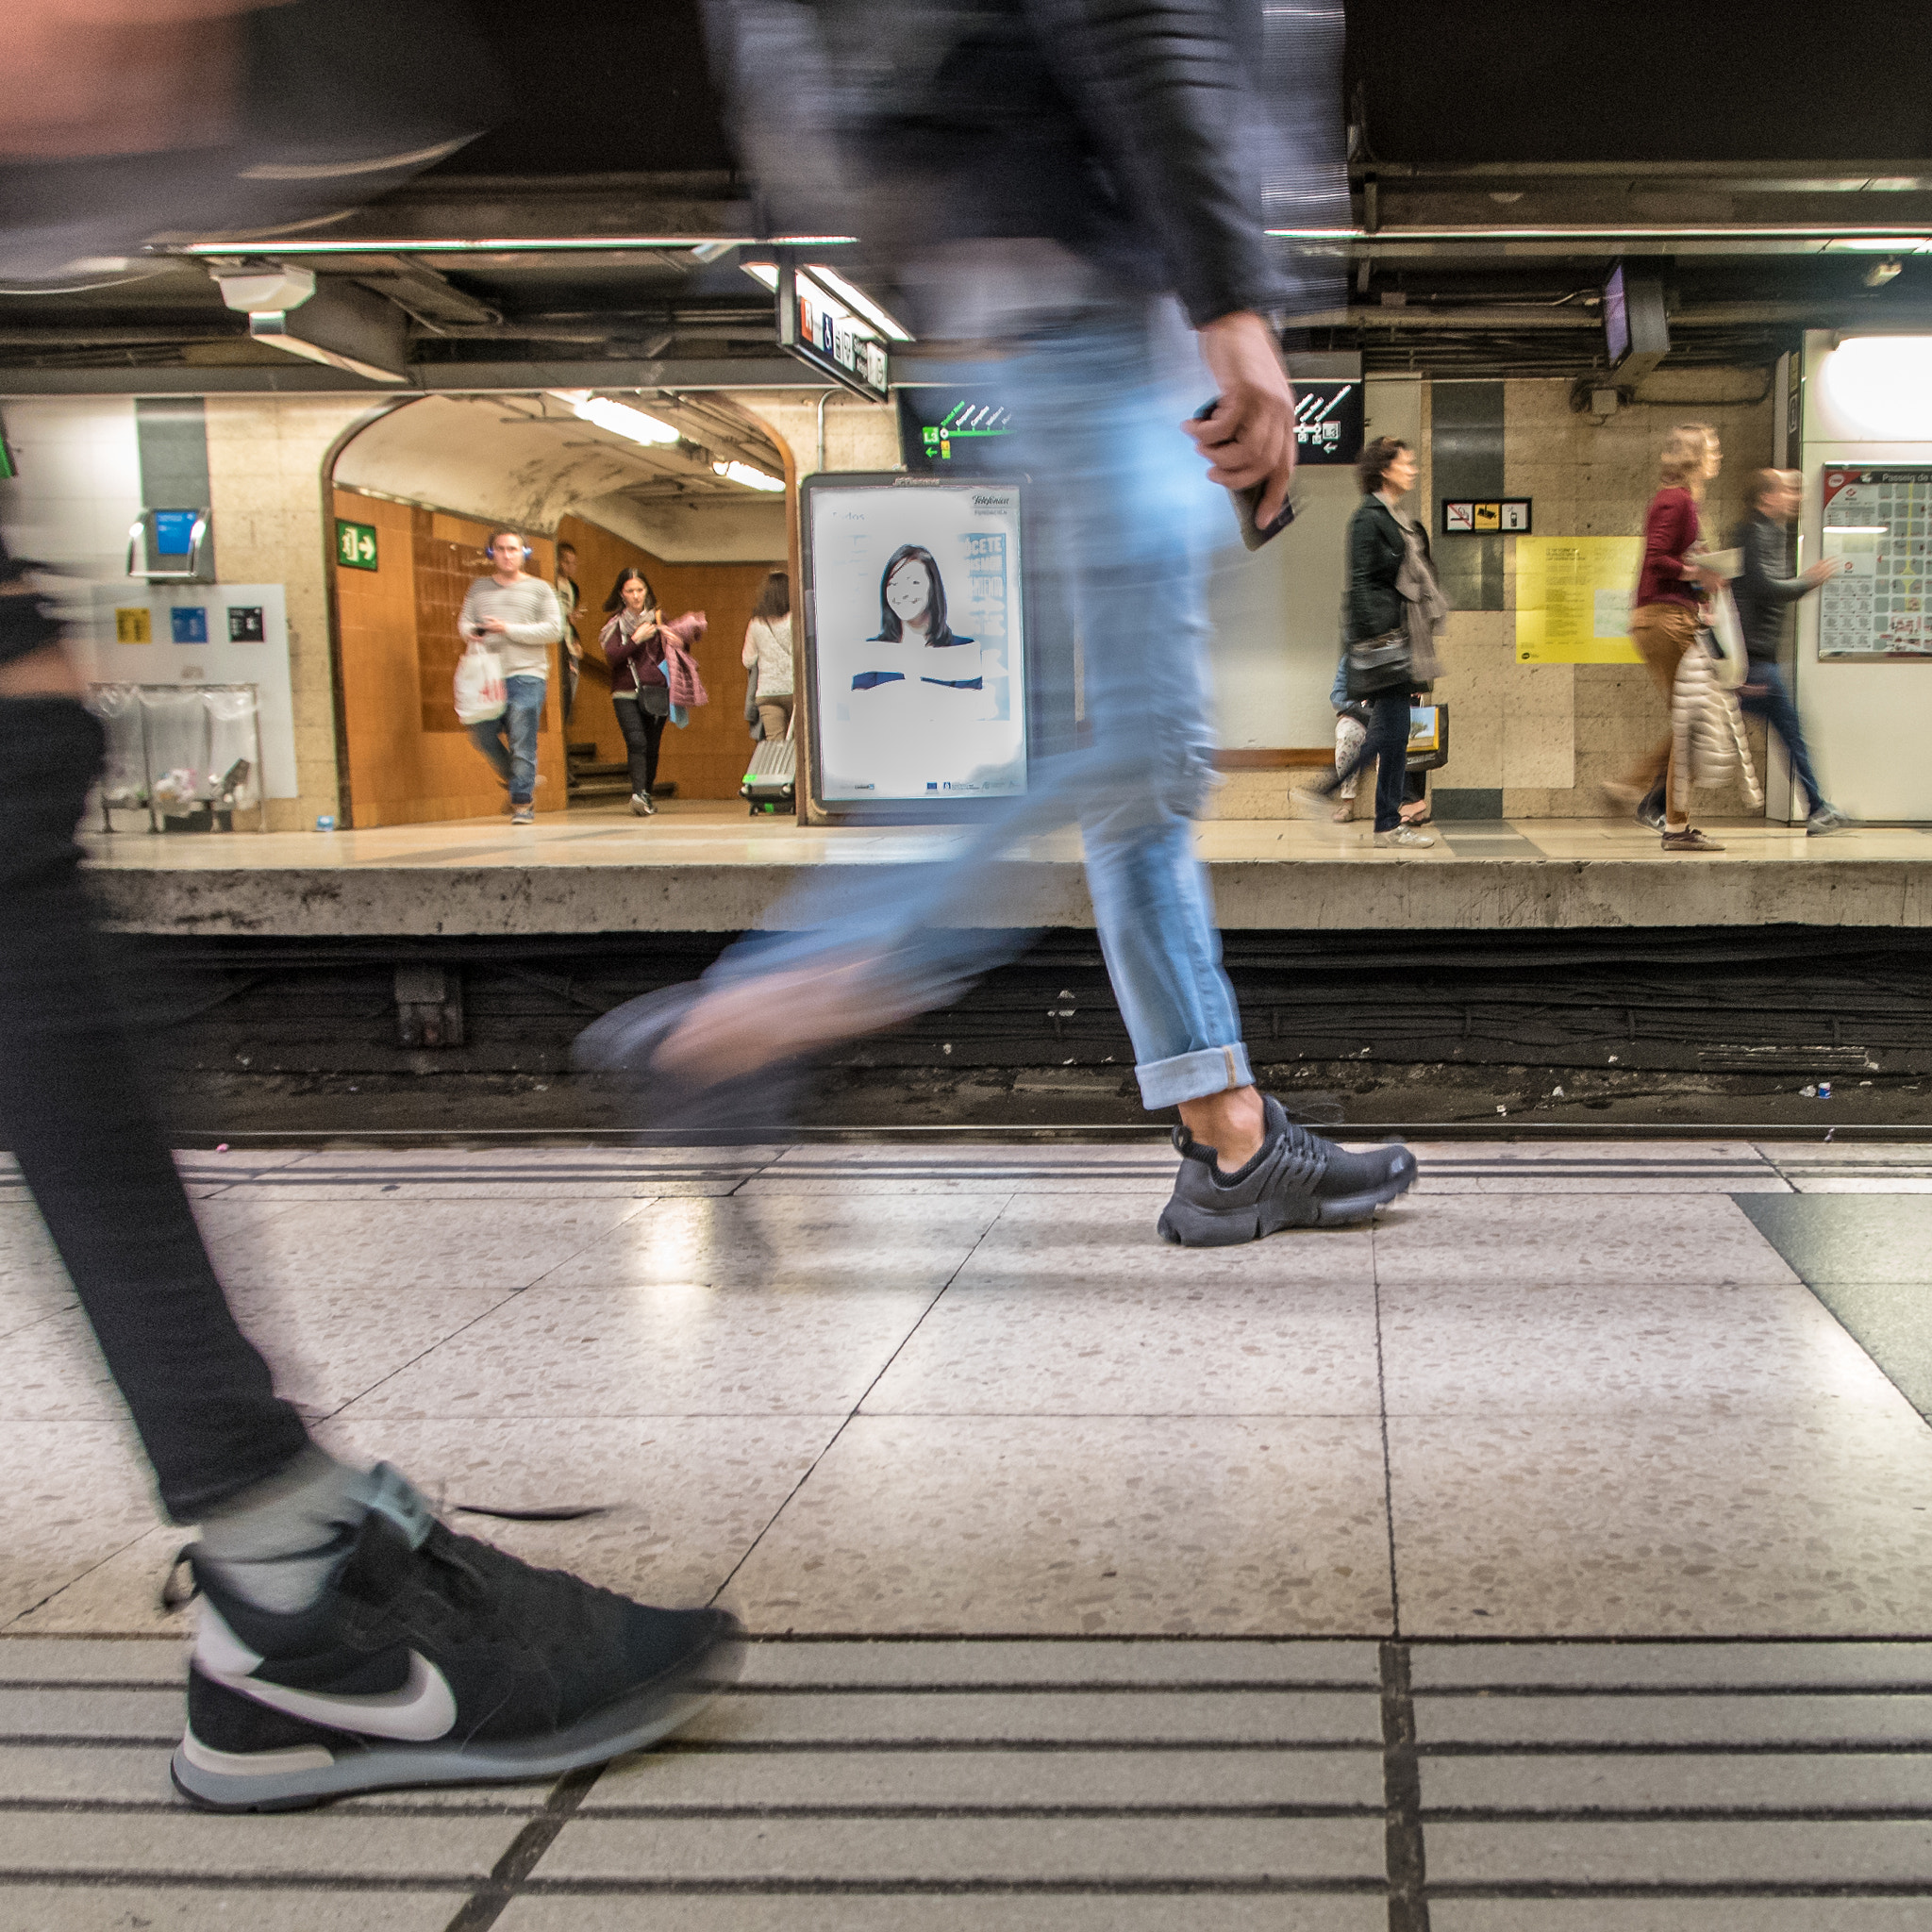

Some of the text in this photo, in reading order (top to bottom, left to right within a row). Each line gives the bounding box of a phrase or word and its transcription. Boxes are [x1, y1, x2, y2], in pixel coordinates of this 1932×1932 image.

[924, 432, 938, 442] L3
[1324, 427, 1338, 438] L3
[1882, 473, 1916, 483] Passeig
